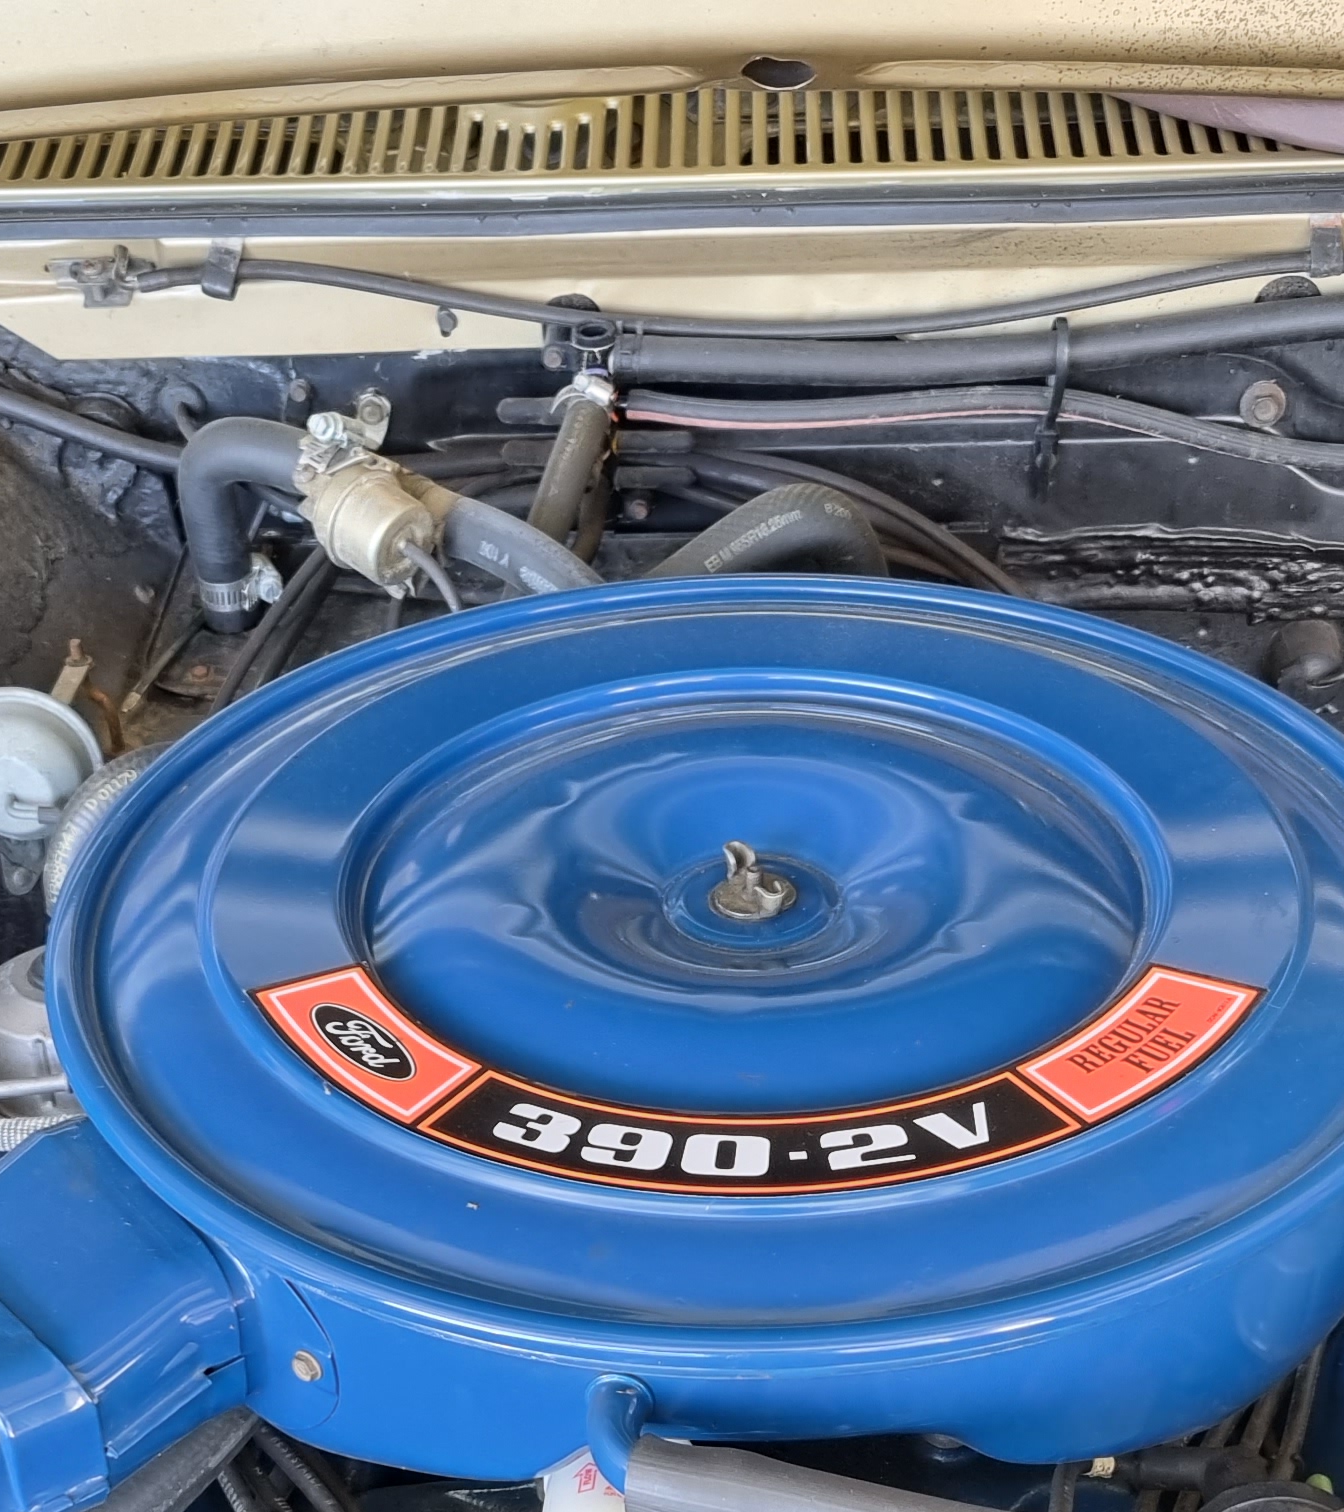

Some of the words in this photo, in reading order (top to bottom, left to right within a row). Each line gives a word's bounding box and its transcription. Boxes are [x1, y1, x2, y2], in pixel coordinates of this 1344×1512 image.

[320, 1015, 390, 1069] Ford
[1067, 996, 1182, 1075] REGULAR
[1124, 1028, 1199, 1075] FUEL
